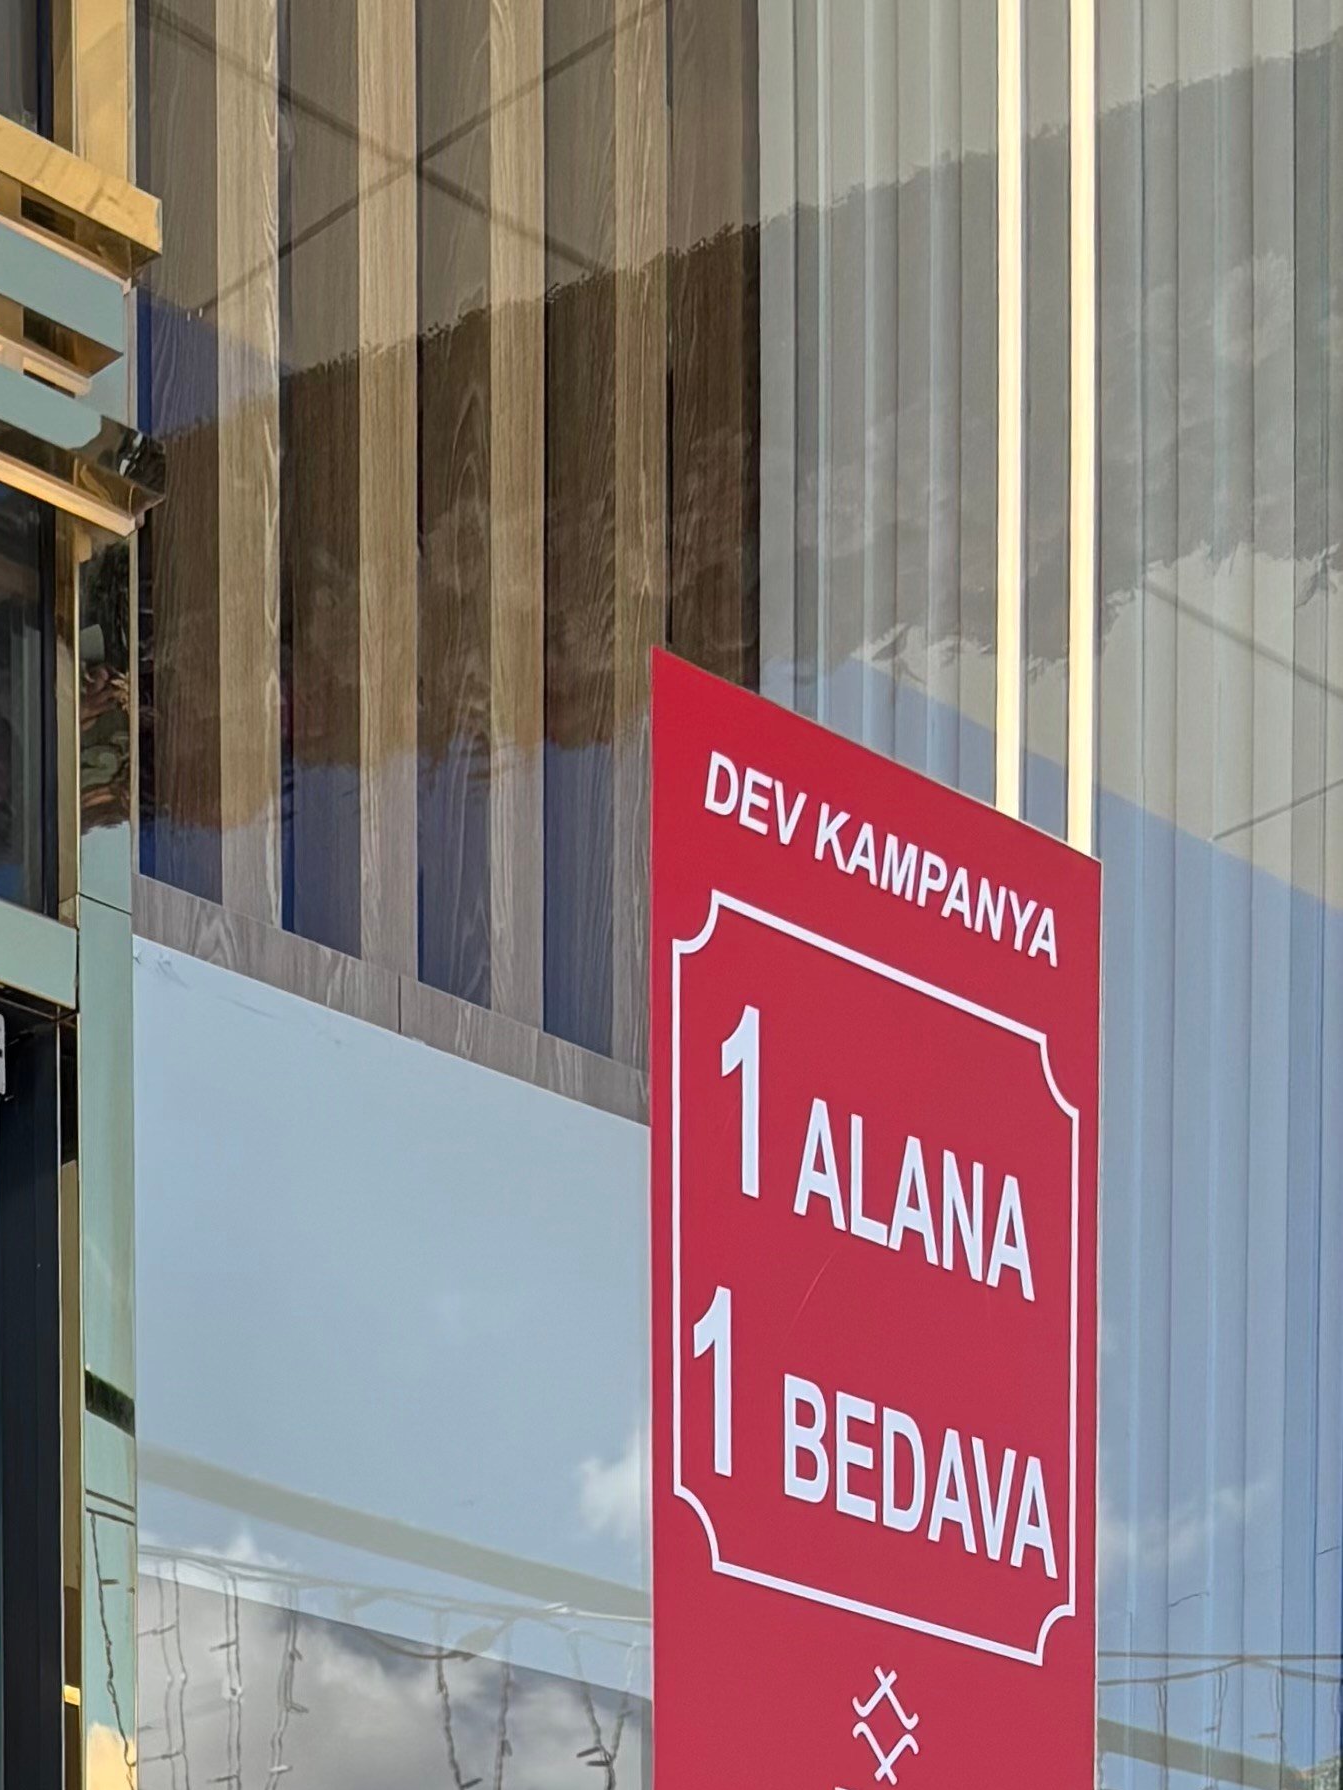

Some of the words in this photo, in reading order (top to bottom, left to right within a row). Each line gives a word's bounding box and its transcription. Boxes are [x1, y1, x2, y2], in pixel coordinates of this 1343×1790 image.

[703, 750, 807, 846] DEV
[814, 802, 1058, 968] KAMPANYA
[720, 1004, 761, 1199] 1
[792, 1097, 1036, 1302] ALANA
[692, 1285, 733, 1478] 1
[782, 1372, 1059, 1580] BEDAVA
